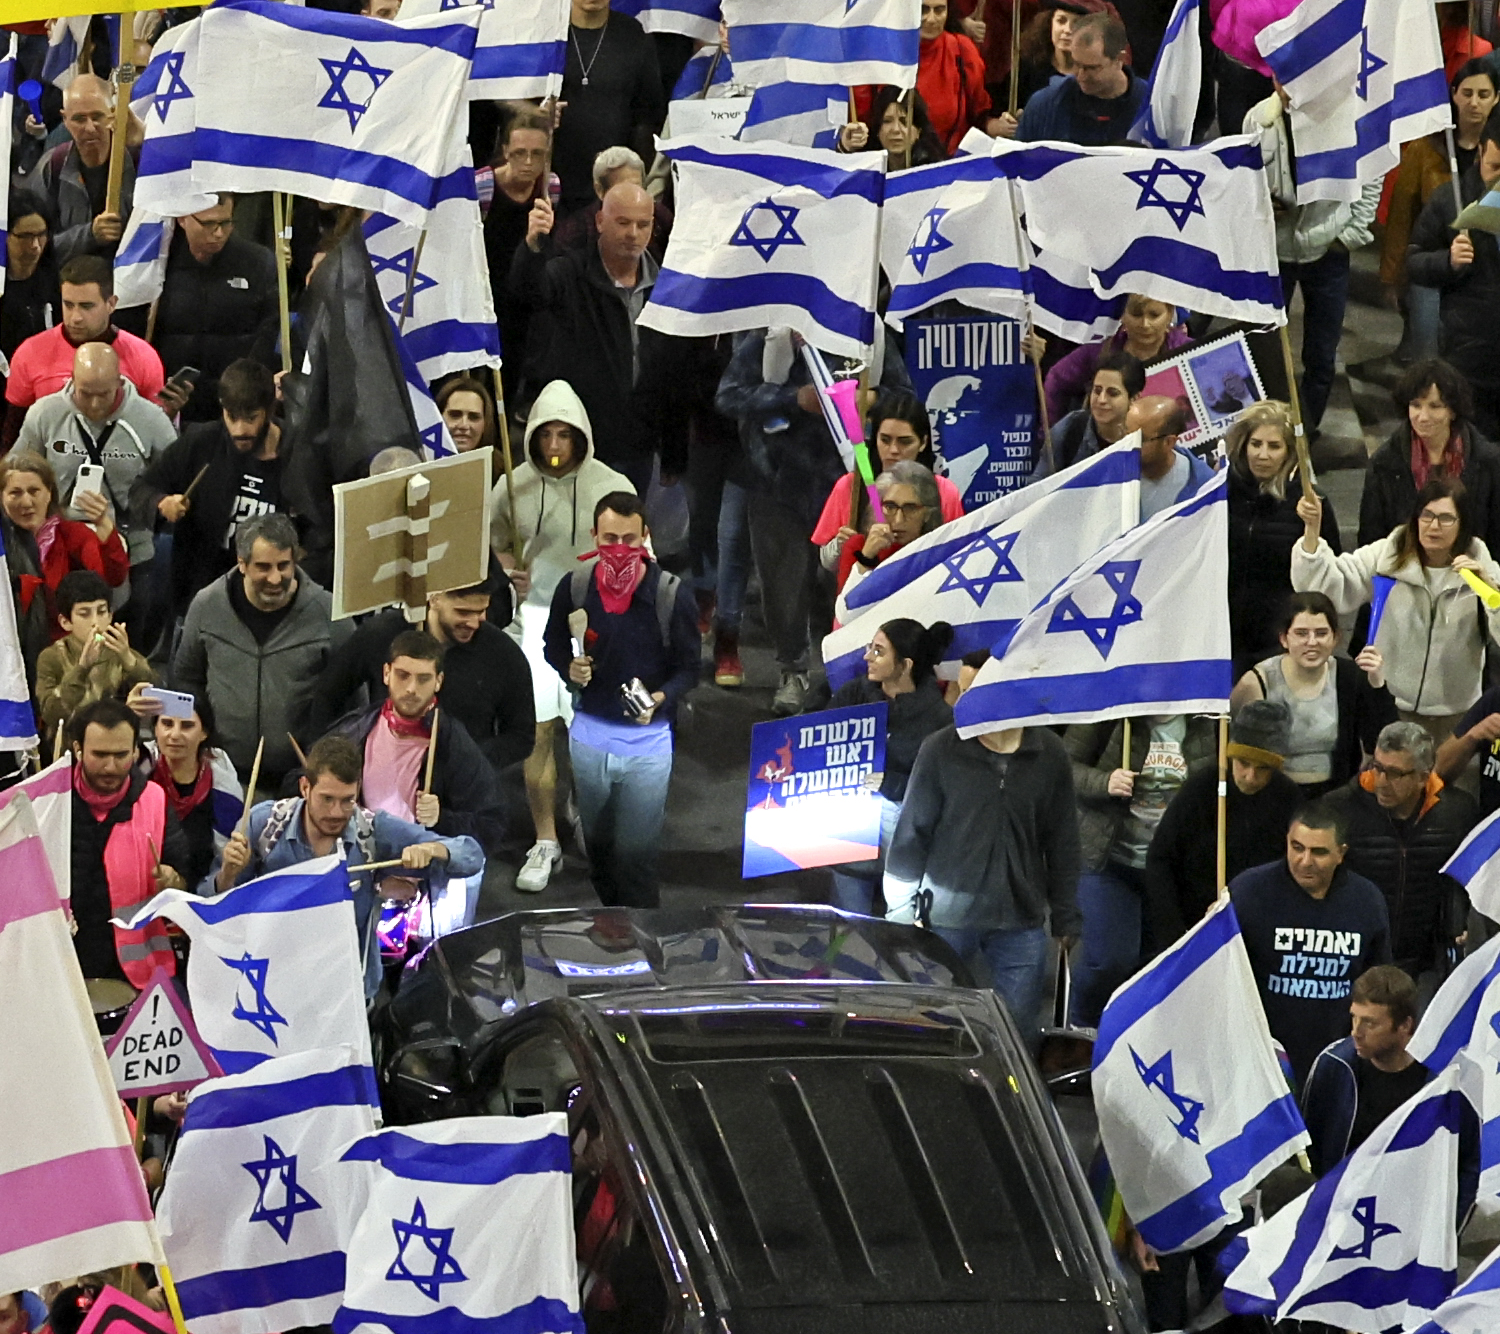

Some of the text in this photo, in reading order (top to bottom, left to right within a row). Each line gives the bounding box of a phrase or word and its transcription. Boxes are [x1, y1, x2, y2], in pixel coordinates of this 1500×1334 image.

[51, 439, 138, 461] Chapion
[799, 716, 876, 747] מלשכת
[825, 740, 875, 769] ראש
[1273, 927, 1361, 957] נאמנים
[1280, 953, 1351, 980] למגילת
[121, 1026, 184, 1057] DEAD
[123, 1054, 182, 1082] END
